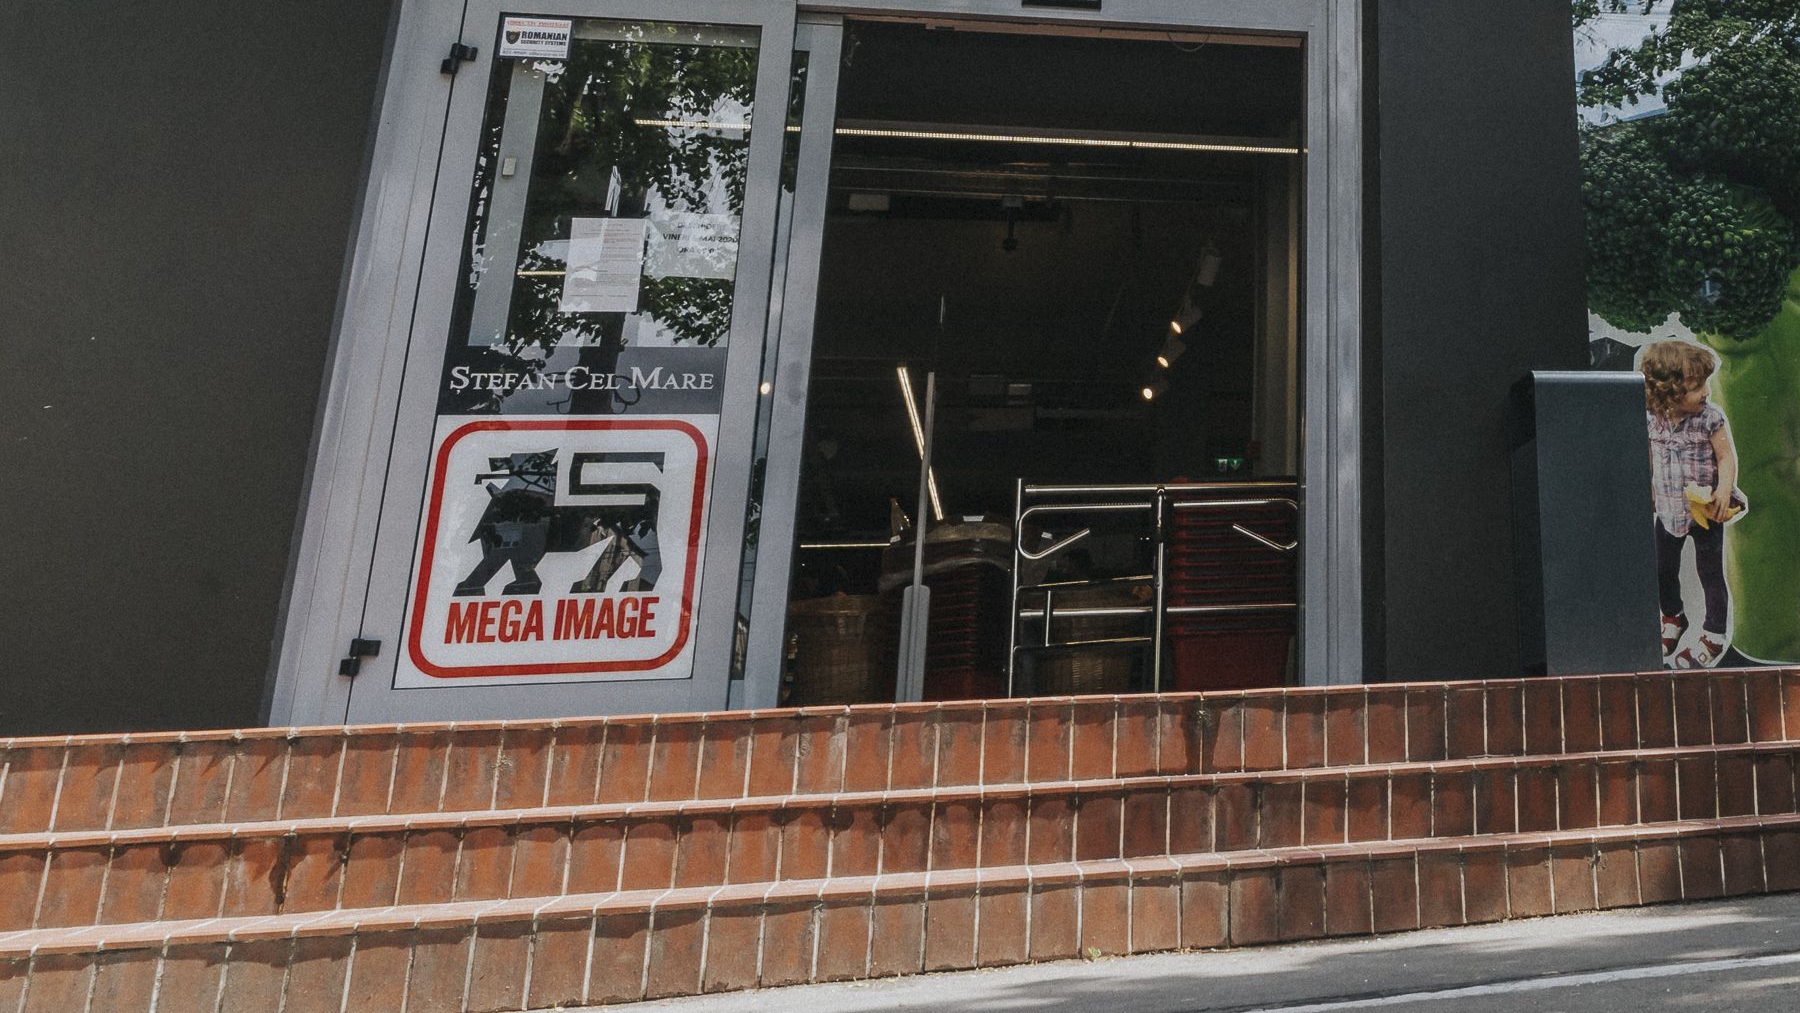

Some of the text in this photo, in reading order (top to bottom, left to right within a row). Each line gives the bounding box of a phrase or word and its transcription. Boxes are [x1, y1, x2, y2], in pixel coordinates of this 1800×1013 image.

[522, 30, 567, 41] ROMANIAN
[444, 596, 660, 644] MEGA IMAGE
